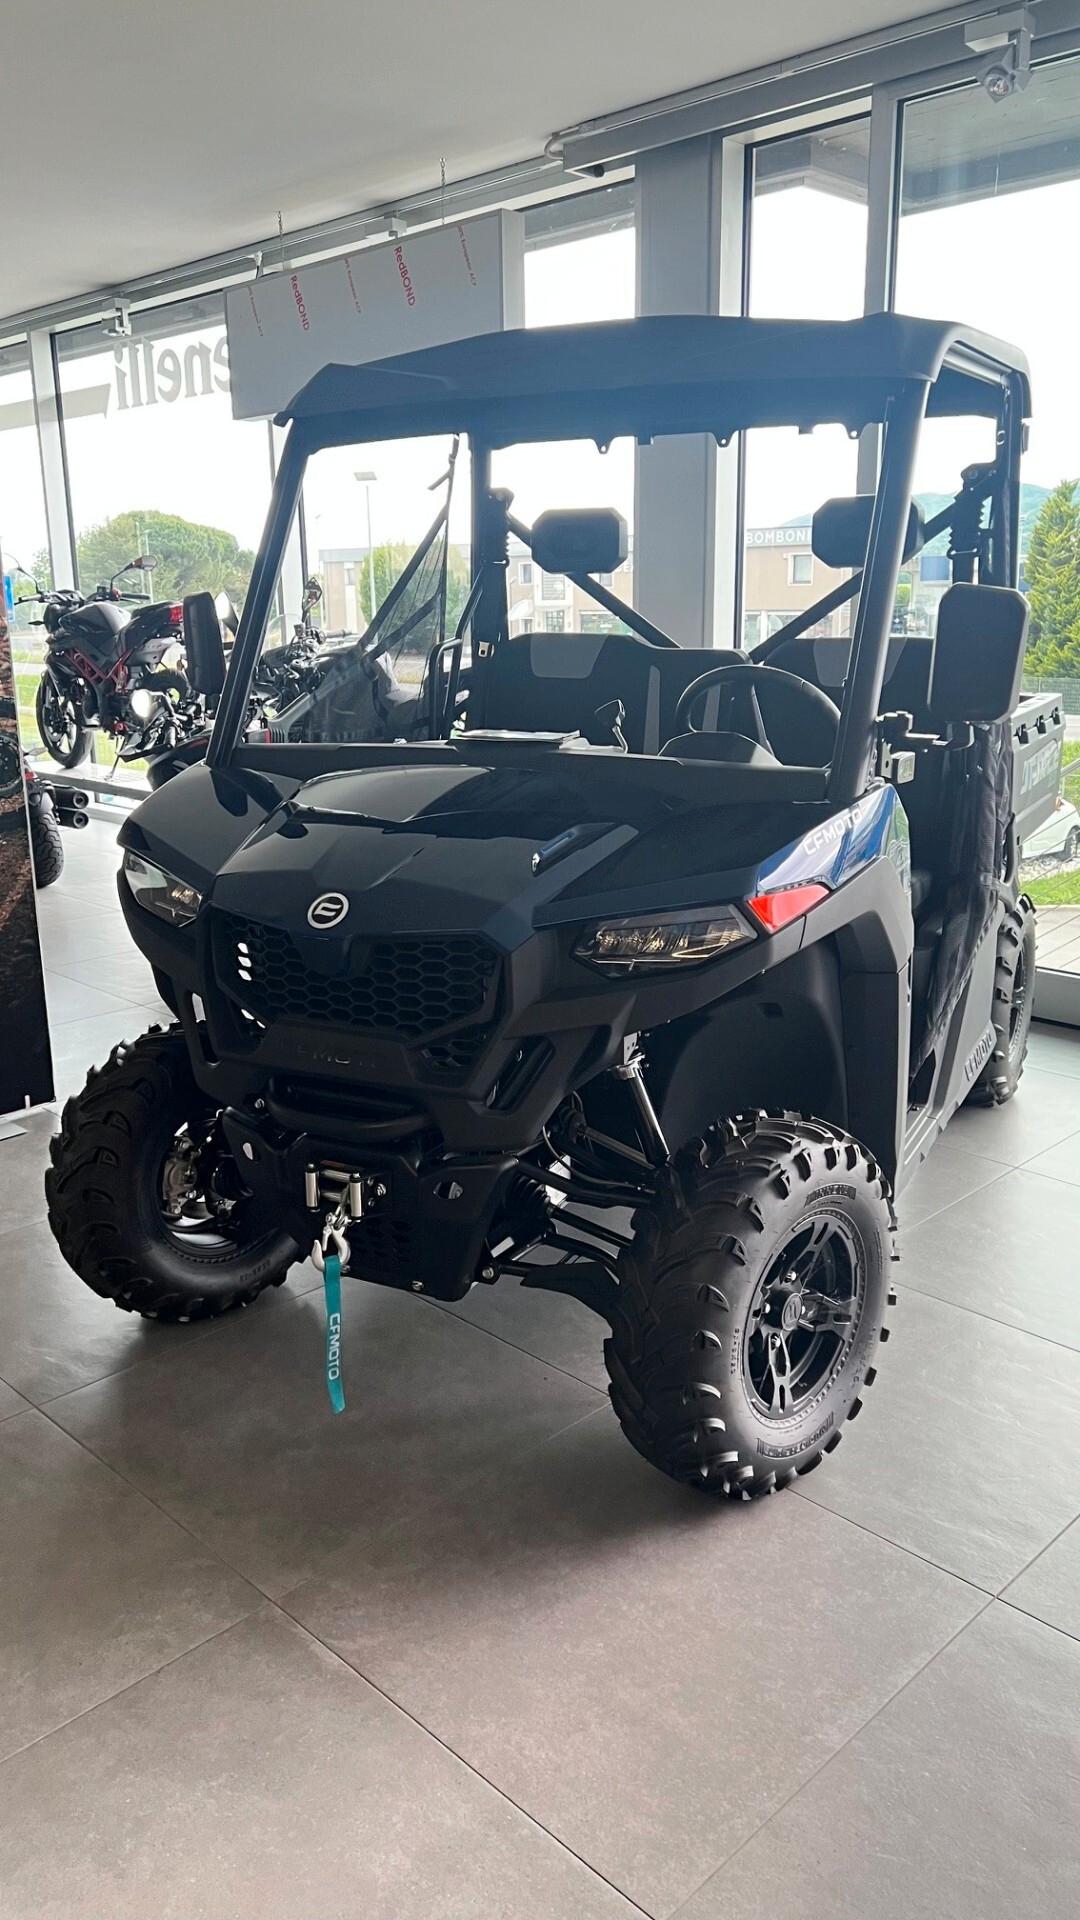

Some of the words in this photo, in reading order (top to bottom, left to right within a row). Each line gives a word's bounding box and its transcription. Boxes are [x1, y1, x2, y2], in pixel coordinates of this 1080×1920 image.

[290, 275, 310, 332] RedBOND
[394, 245, 416, 306] RedBOND
[803, 808, 864, 855] CFMOTO
[328, 1312, 340, 1380] CFMOTO
